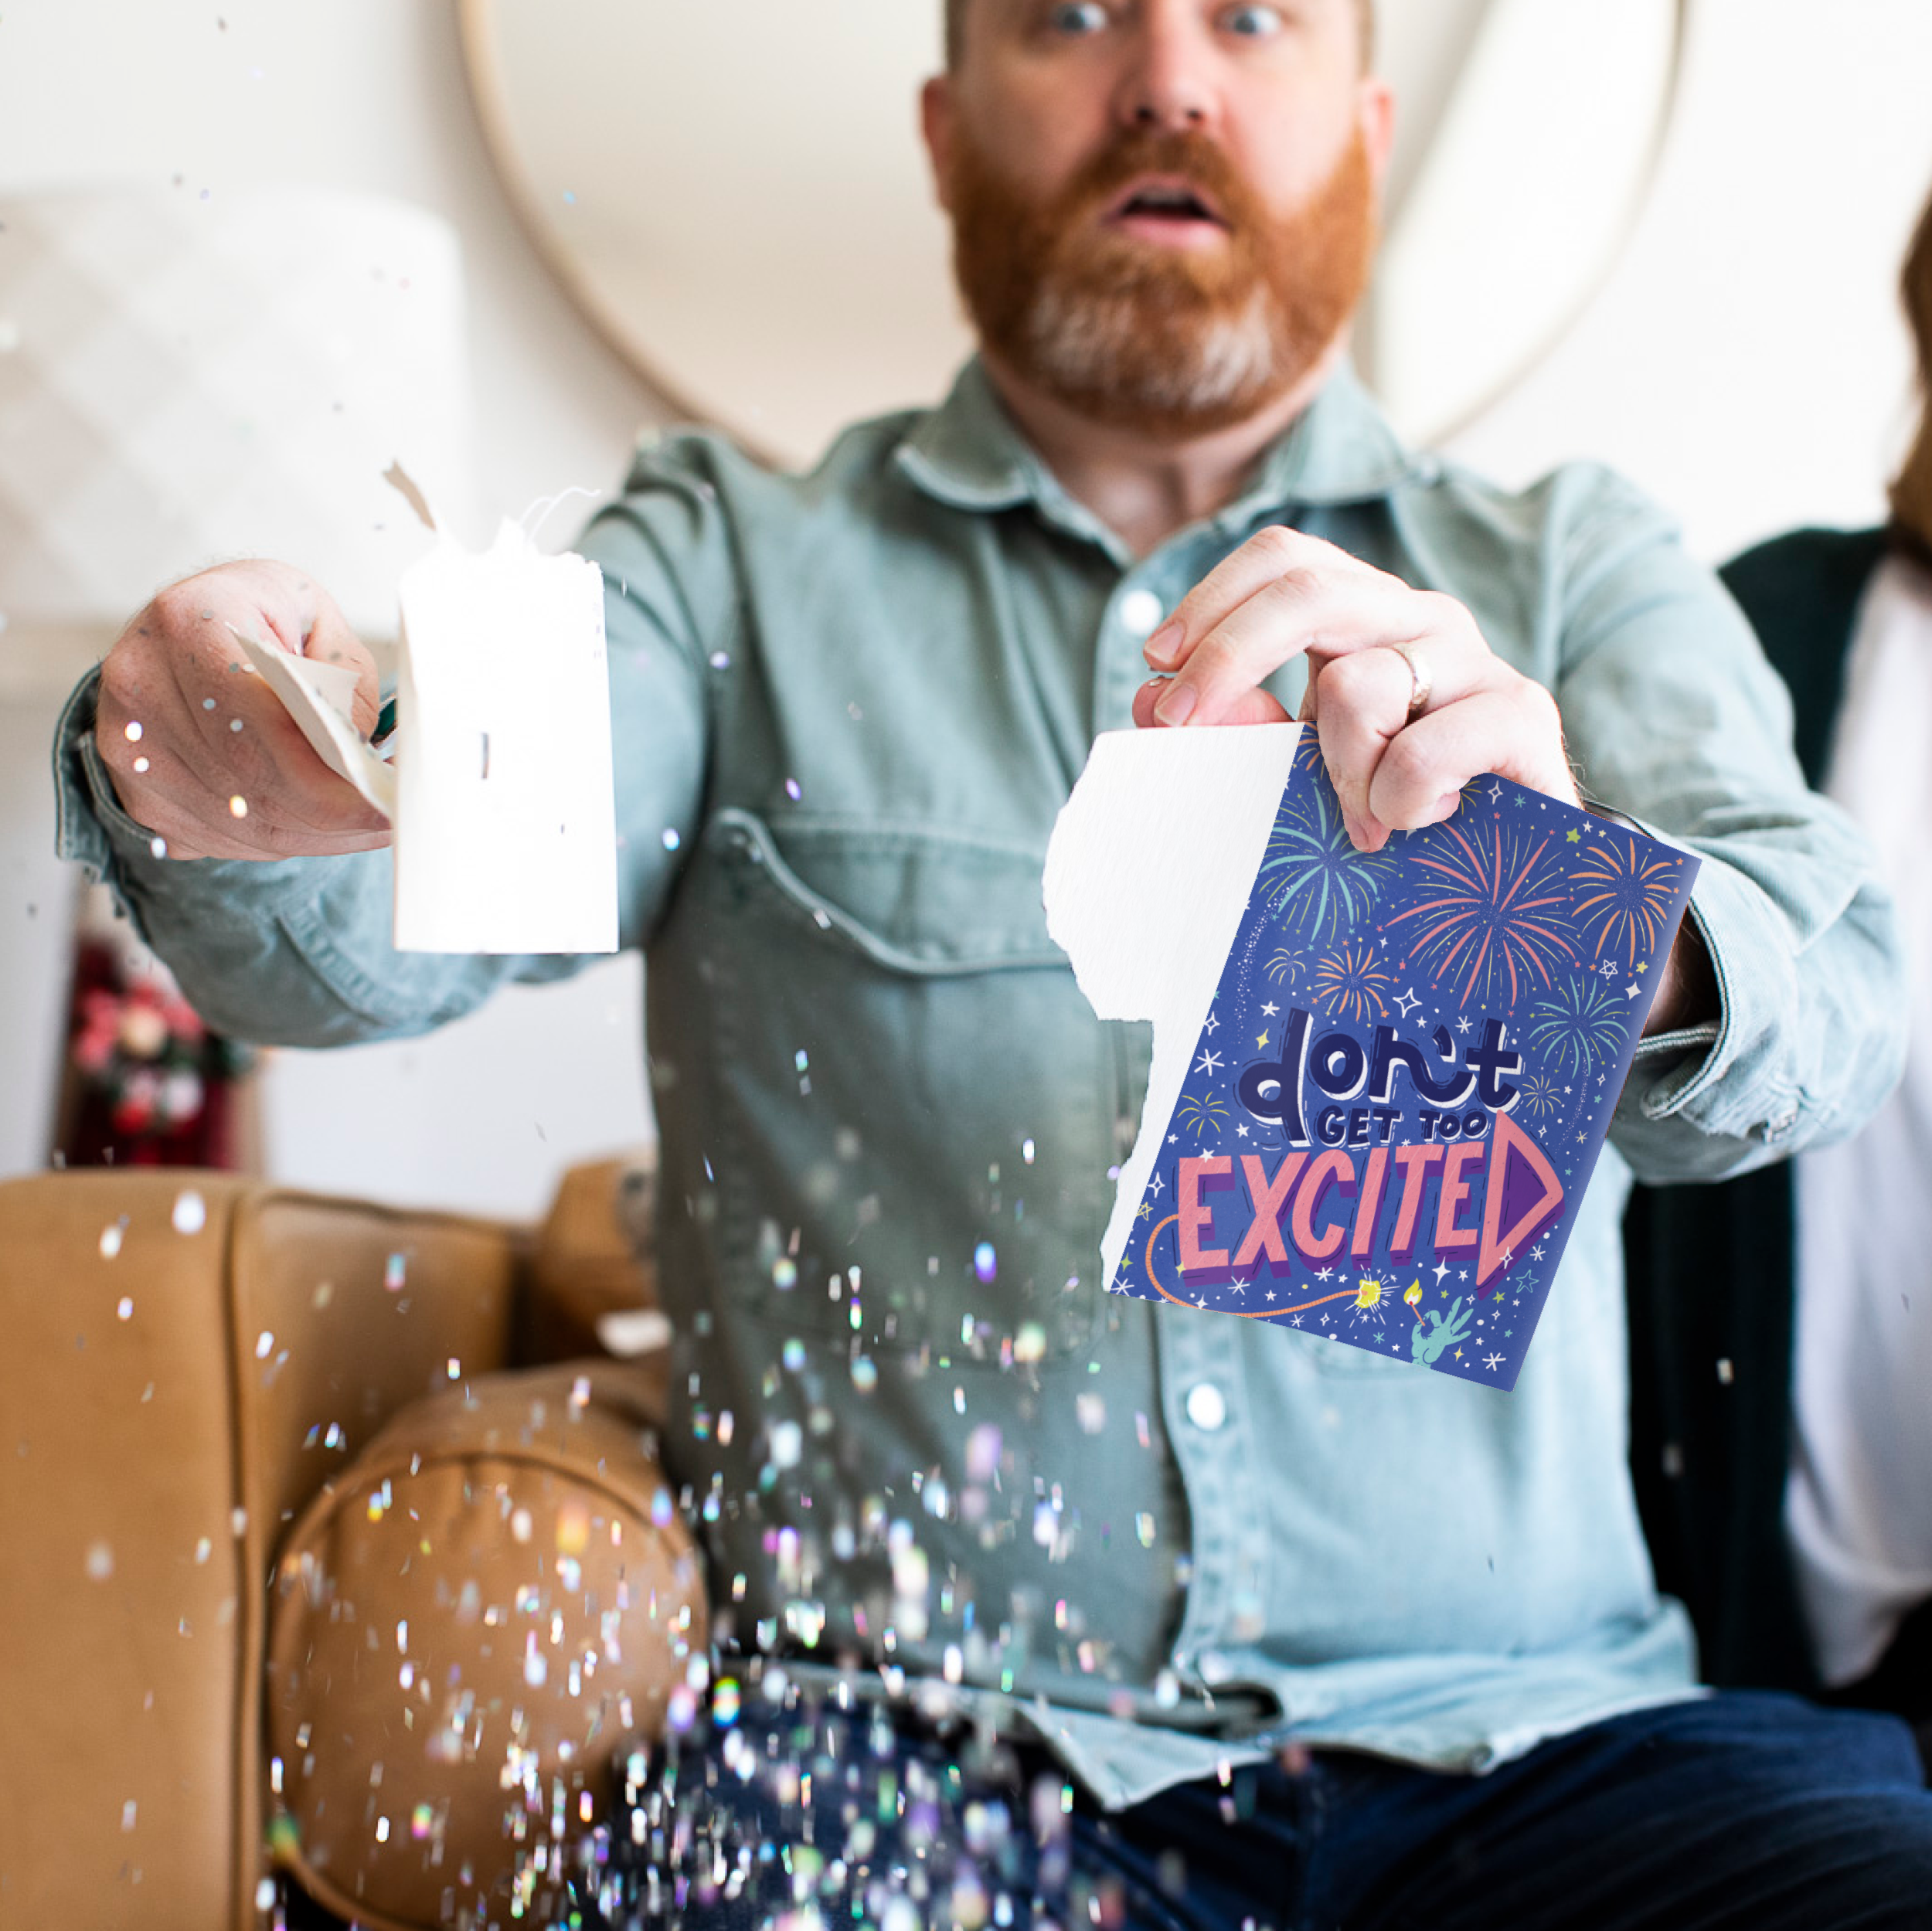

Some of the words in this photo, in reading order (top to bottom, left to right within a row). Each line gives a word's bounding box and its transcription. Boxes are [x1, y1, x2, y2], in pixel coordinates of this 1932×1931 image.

[1239, 1008, 1522, 1147] don't
[1316, 1105, 1402, 1147] GET
[1419, 1109, 1488, 1143] TOO
[1178, 1110, 1564, 1299] EXCITED
